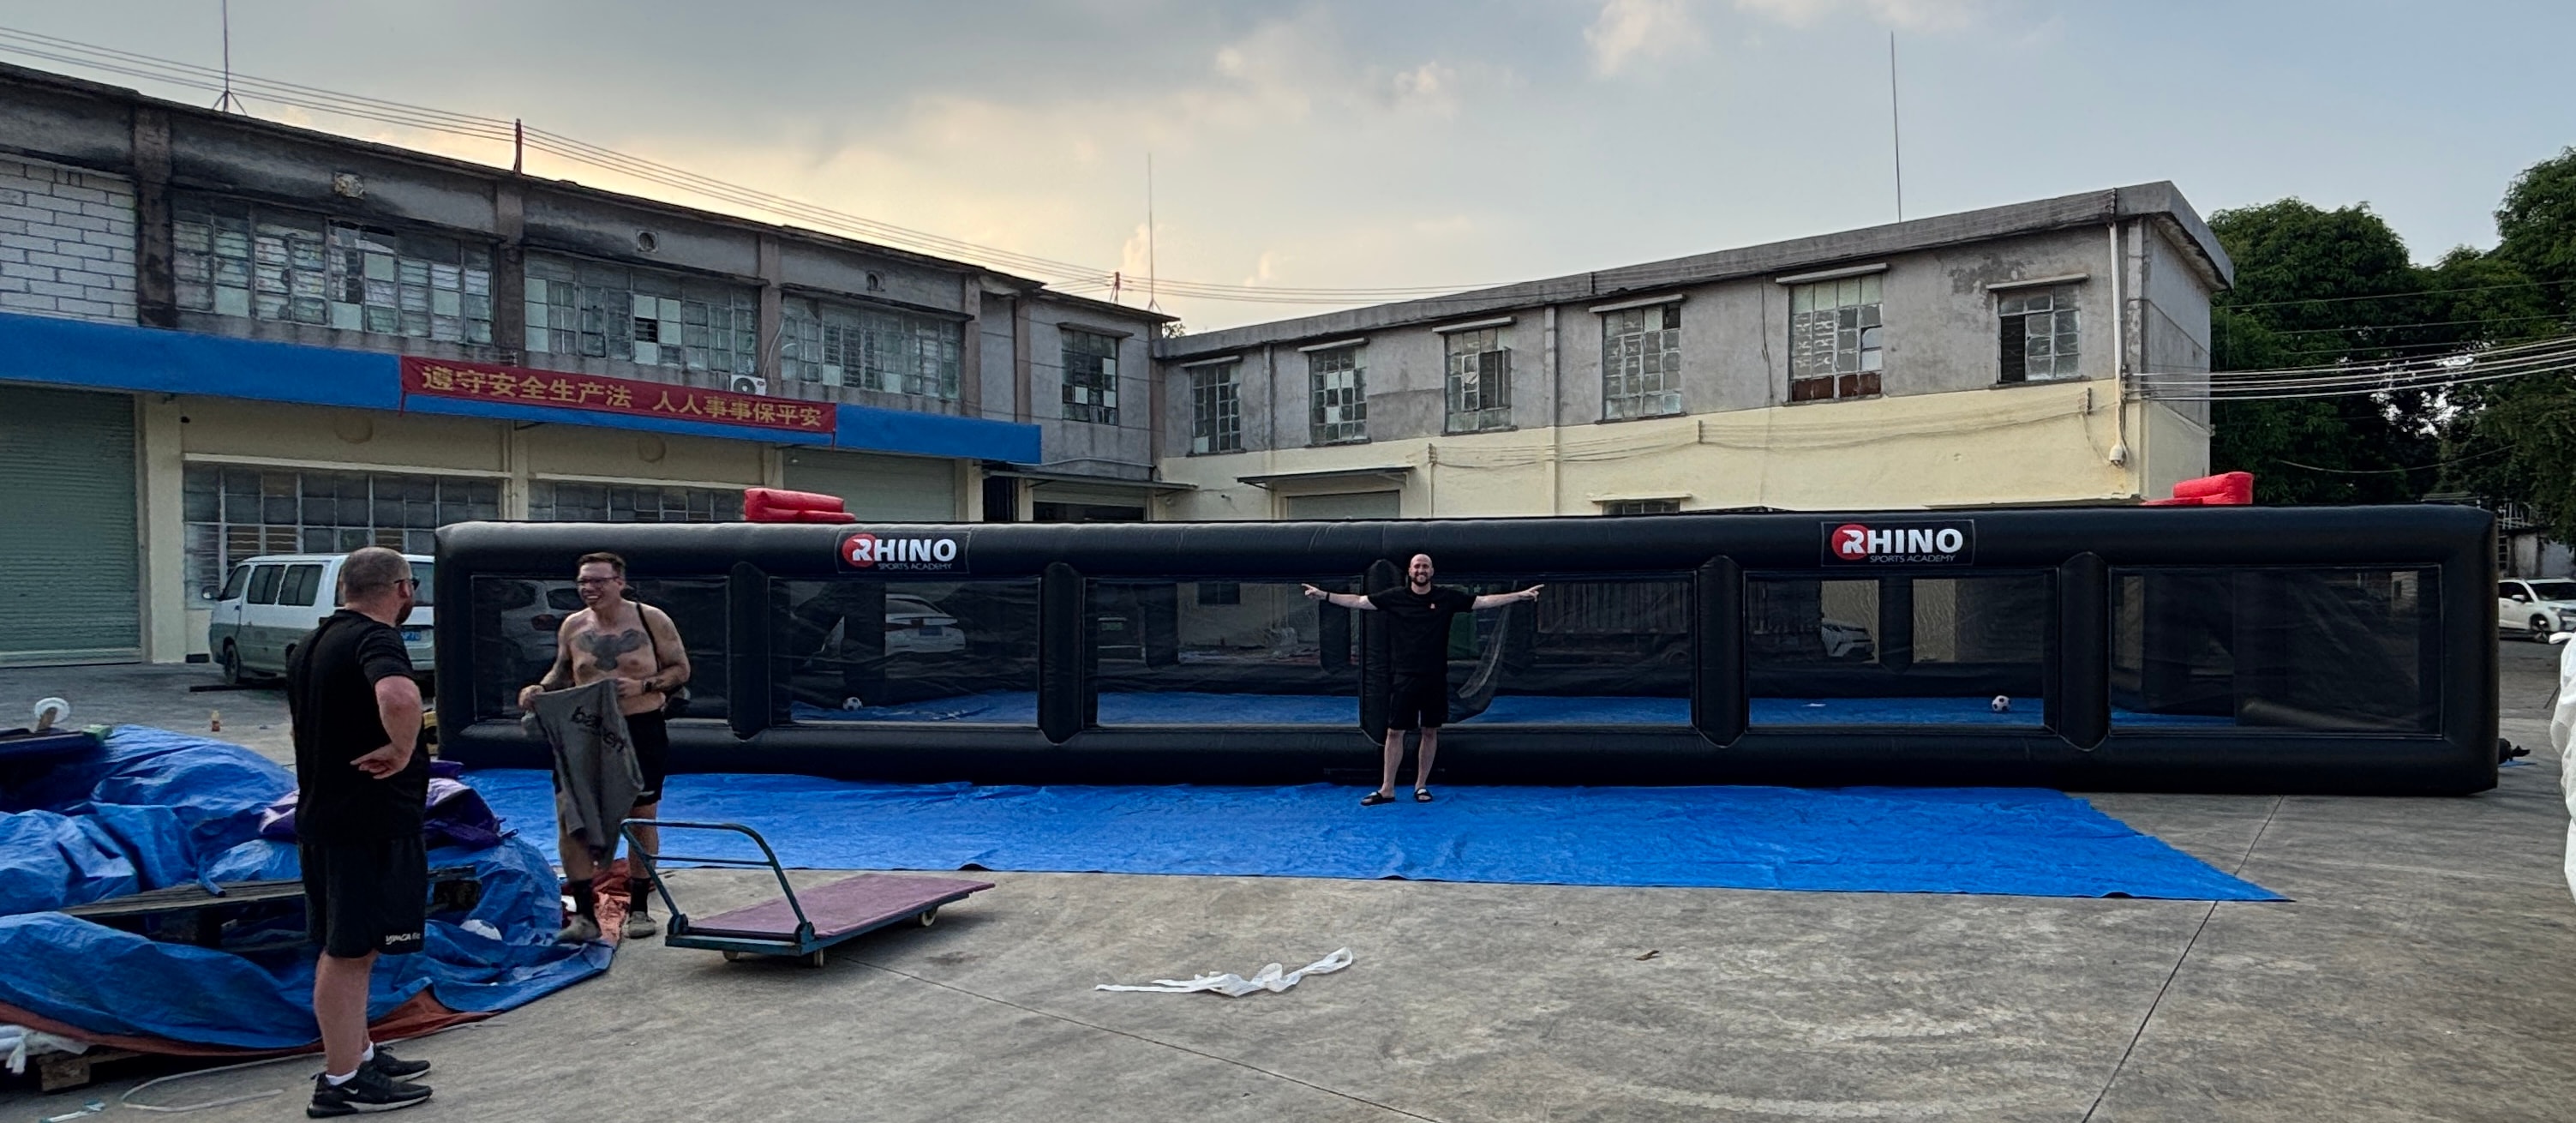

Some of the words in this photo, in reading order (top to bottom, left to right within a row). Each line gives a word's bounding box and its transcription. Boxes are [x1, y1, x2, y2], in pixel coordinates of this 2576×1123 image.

[422, 365, 633, 408] 遵守安全生产法
[652, 390, 822, 427] 人人事事保平安
[852, 538, 957, 562] RHINO
[1842, 528, 1963, 554] RHINO
[1869, 555, 1905, 563] SPORTS
[1906, 554, 1956, 562] ACADEMY
